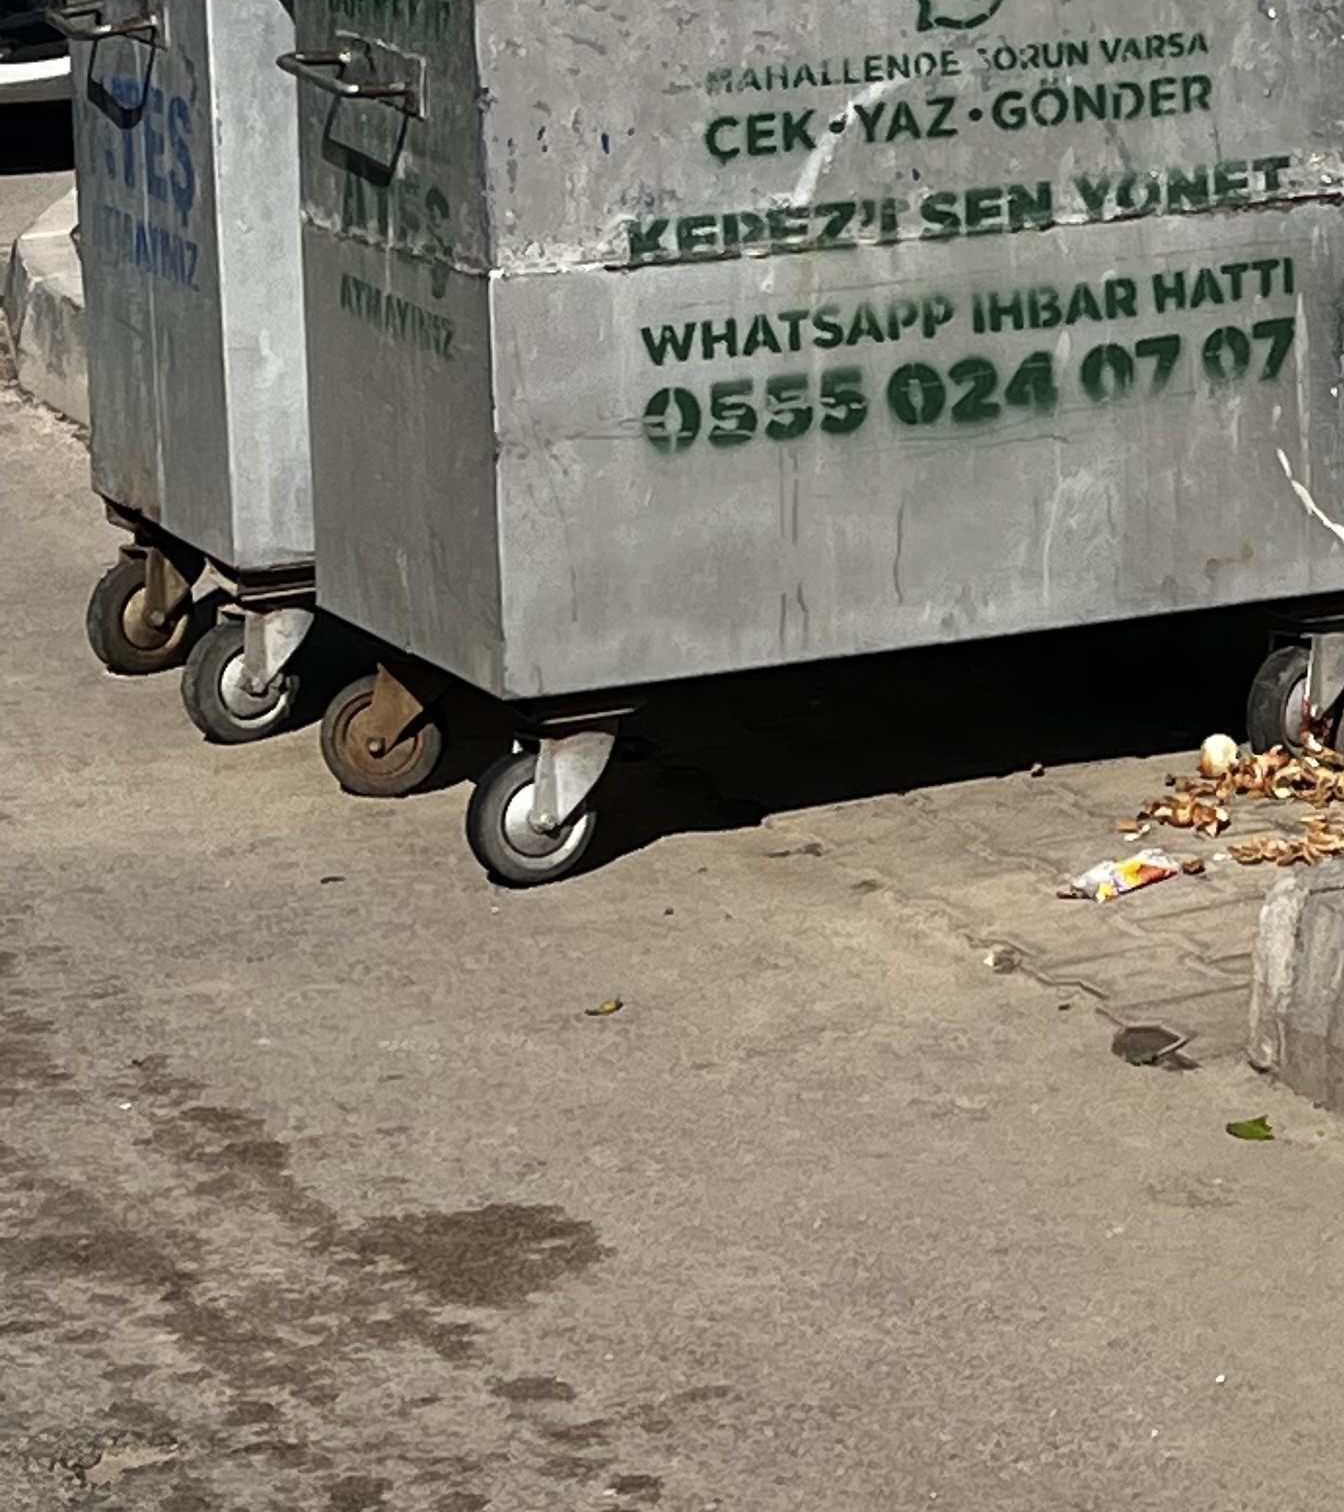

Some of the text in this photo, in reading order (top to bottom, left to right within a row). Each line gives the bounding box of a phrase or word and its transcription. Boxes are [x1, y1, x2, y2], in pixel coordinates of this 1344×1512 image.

[705, 49, 961, 95] MAHALLENDE
[1100, 32, 1209, 64] VARSA
[853, 97, 959, 143] YAZ
[991, 74, 1213, 130] GÖNDER
[919, 180, 1051, 241] SEN
[640, 294, 955, 366] WHATSAPP
[1152, 257, 1295, 314] HATTI
[642, 316, 1295, 454] 0555 024 07 07
